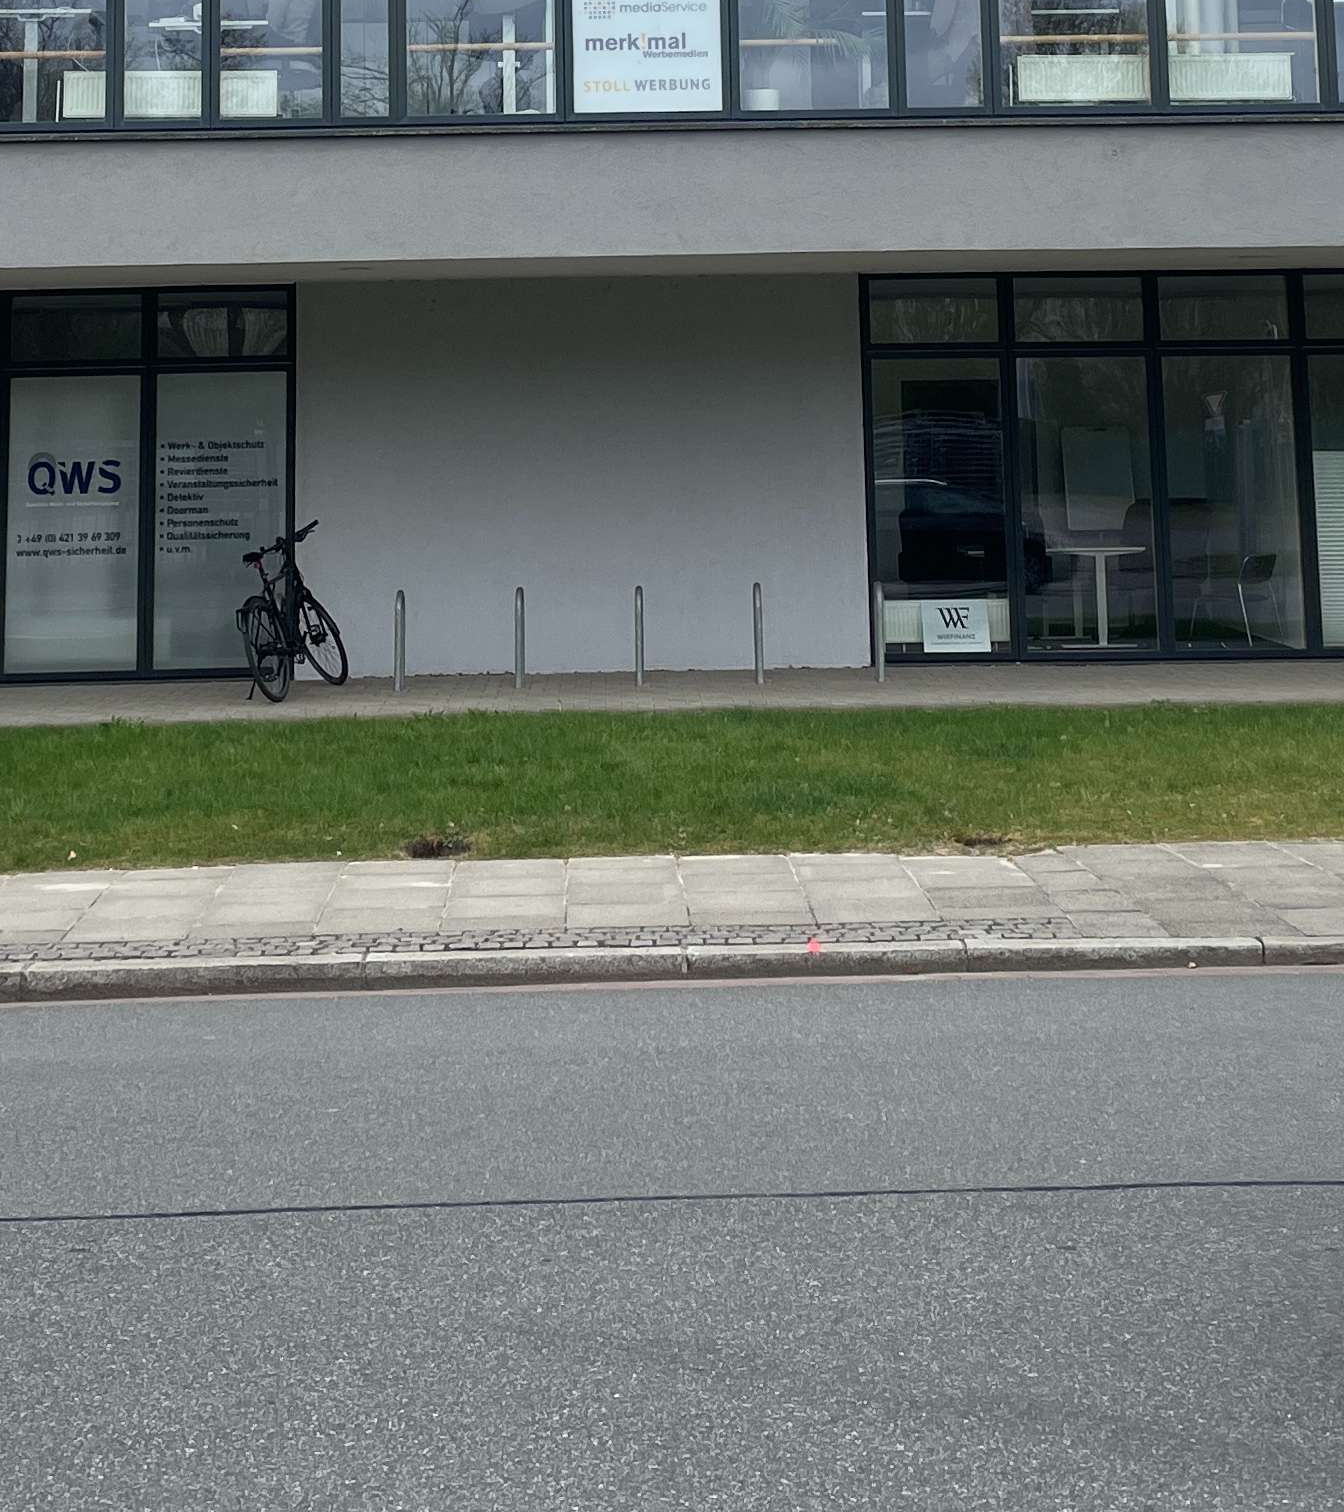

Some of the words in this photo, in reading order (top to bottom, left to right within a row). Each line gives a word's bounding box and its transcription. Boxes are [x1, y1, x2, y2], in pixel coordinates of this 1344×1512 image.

[619, 1, 707, 14] mediaService
[642, 50, 709, 59] Werbemedien
[583, 79, 631, 93] STOLL
[635, 77, 711, 92] WERBUNG
[198, 441, 205, 449] &
[207, 440, 264, 451] Objektschutz
[167, 454, 229, 463] Messedienste
[167, 467, 228, 476] Revierdienste
[27, 459, 122, 496] QWS
[167, 478, 278, 490] Veranstaltungssicherheit
[167, 492, 204, 502] Detektiv
[167, 506, 209, 515] Doorman
[167, 518, 239, 528] Personenschutz
[59, 533, 74, 543] 421
[77, 532, 89, 542] 39
[91, 532, 102, 541] 69
[104, 531, 121, 541] 309
[166, 531, 250, 541] Qualitätssicherung
[16, 546, 127, 558] www.qws-sicherheit.de
